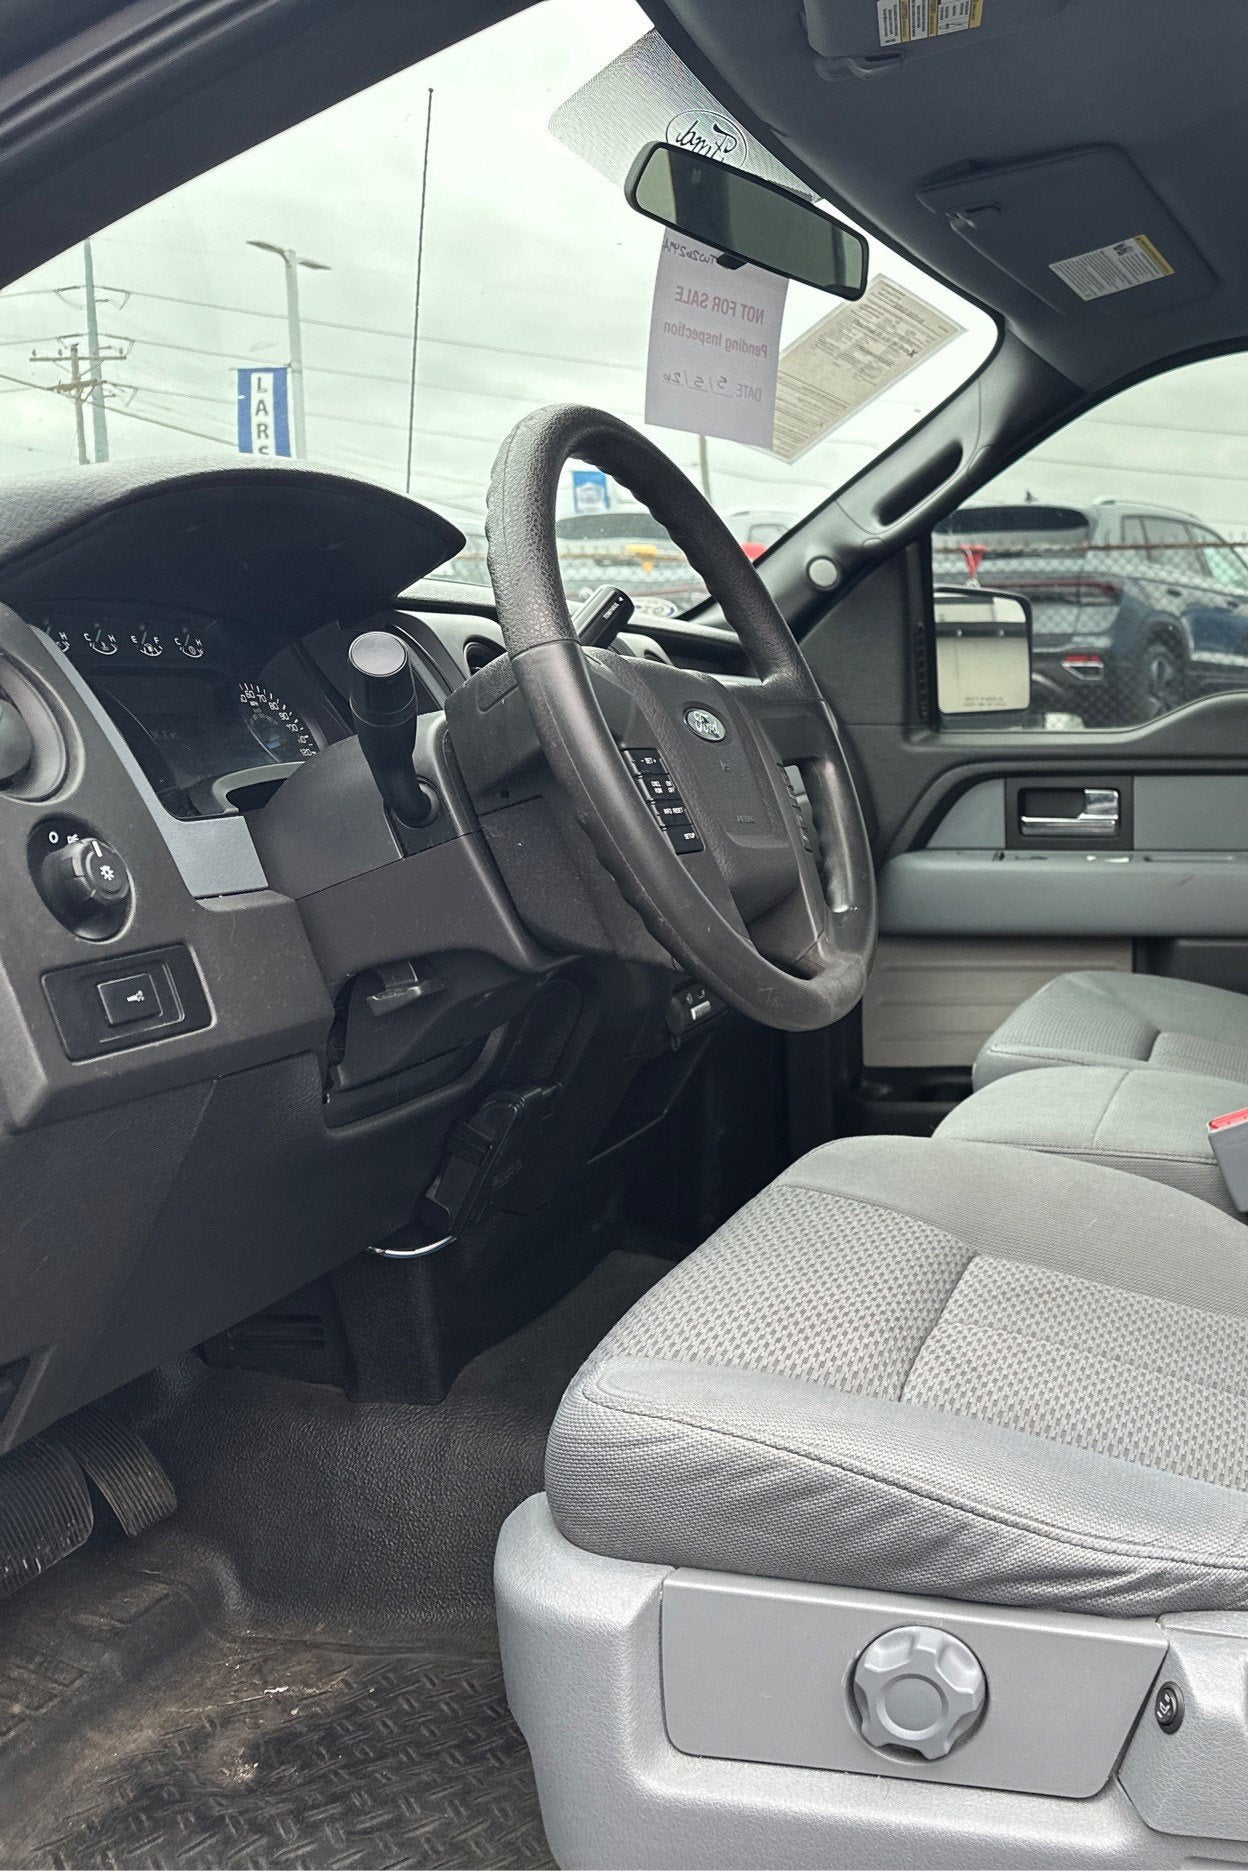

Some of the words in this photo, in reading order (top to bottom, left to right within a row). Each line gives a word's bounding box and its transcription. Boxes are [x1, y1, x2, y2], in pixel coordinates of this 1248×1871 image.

[131, 635, 138, 643] E
[153, 636, 161, 644] F
[693, 711, 720, 738] Ford
